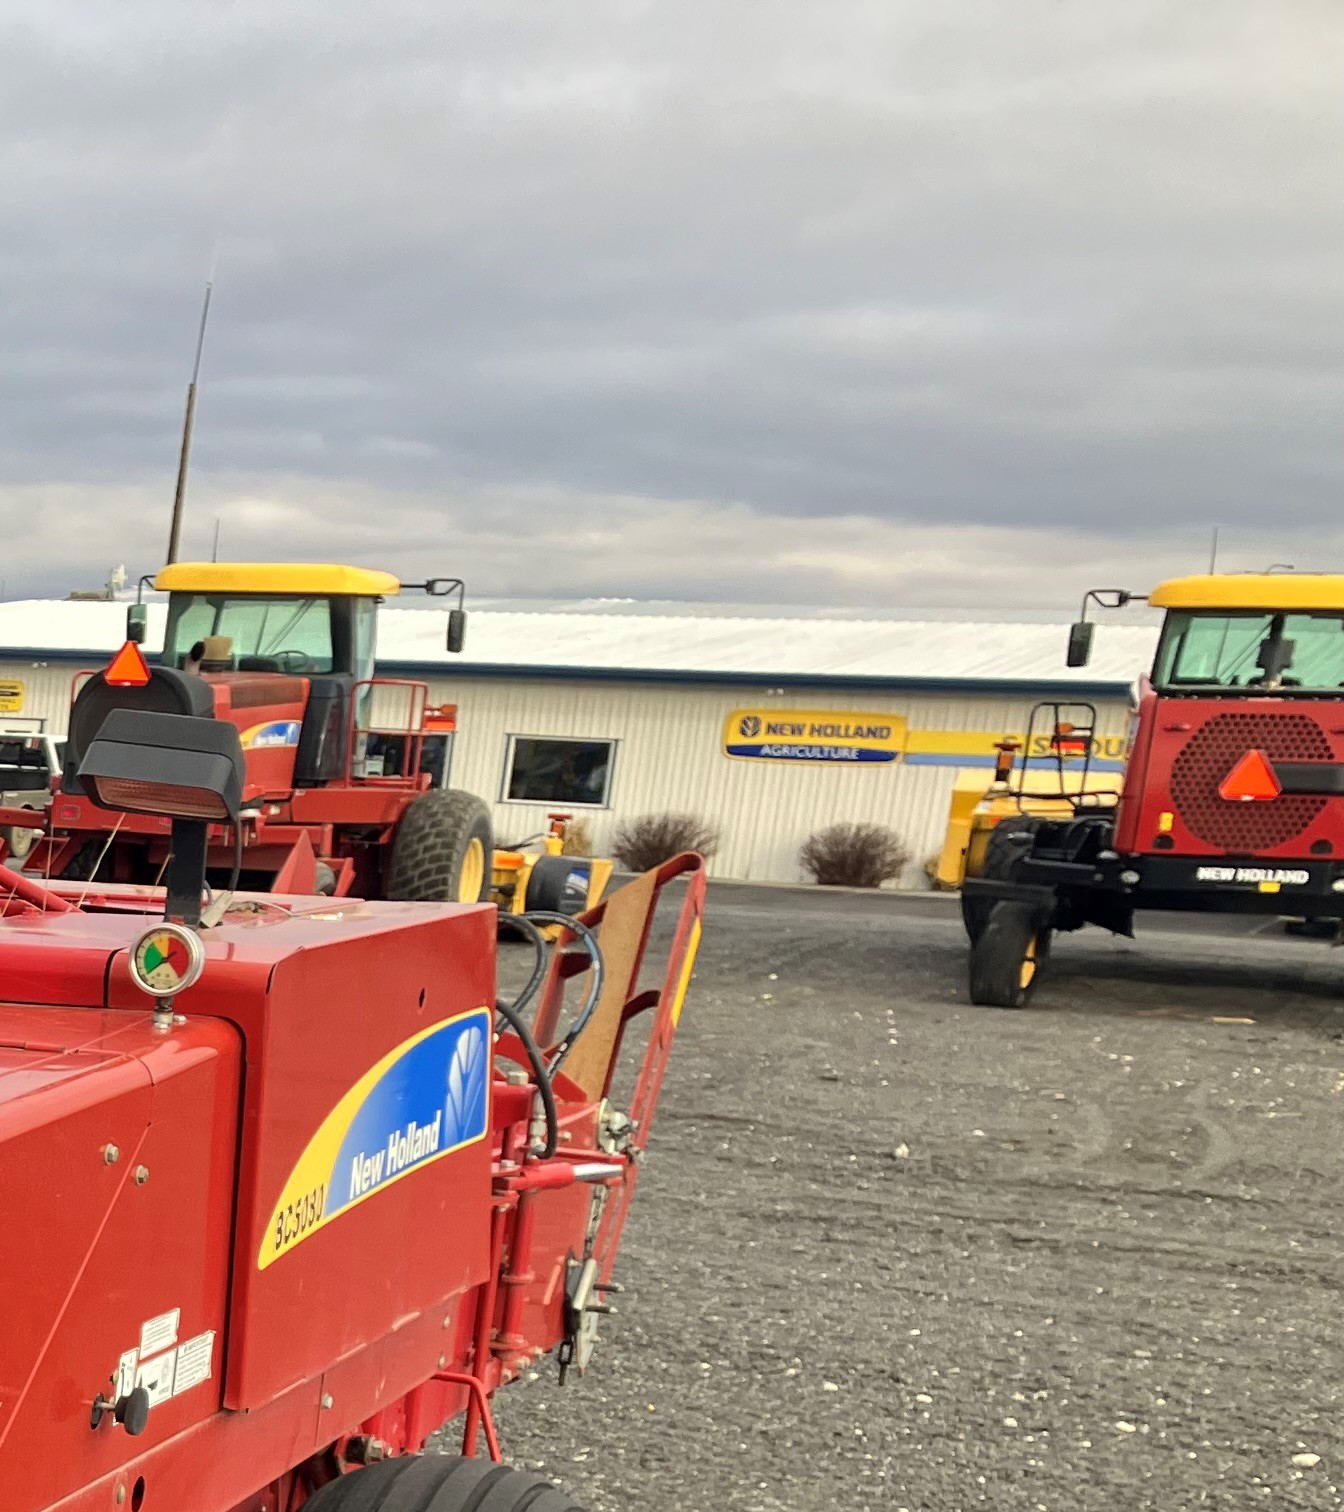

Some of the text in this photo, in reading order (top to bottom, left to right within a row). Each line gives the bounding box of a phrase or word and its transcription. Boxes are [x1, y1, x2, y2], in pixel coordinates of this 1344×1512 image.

[767, 722, 891, 739] NEW HOLLAND
[759, 744, 860, 760] AGRICULTURE
[1196, 866, 1310, 885] NEW HOLLAND
[349, 1109, 442, 1200] New Holland
